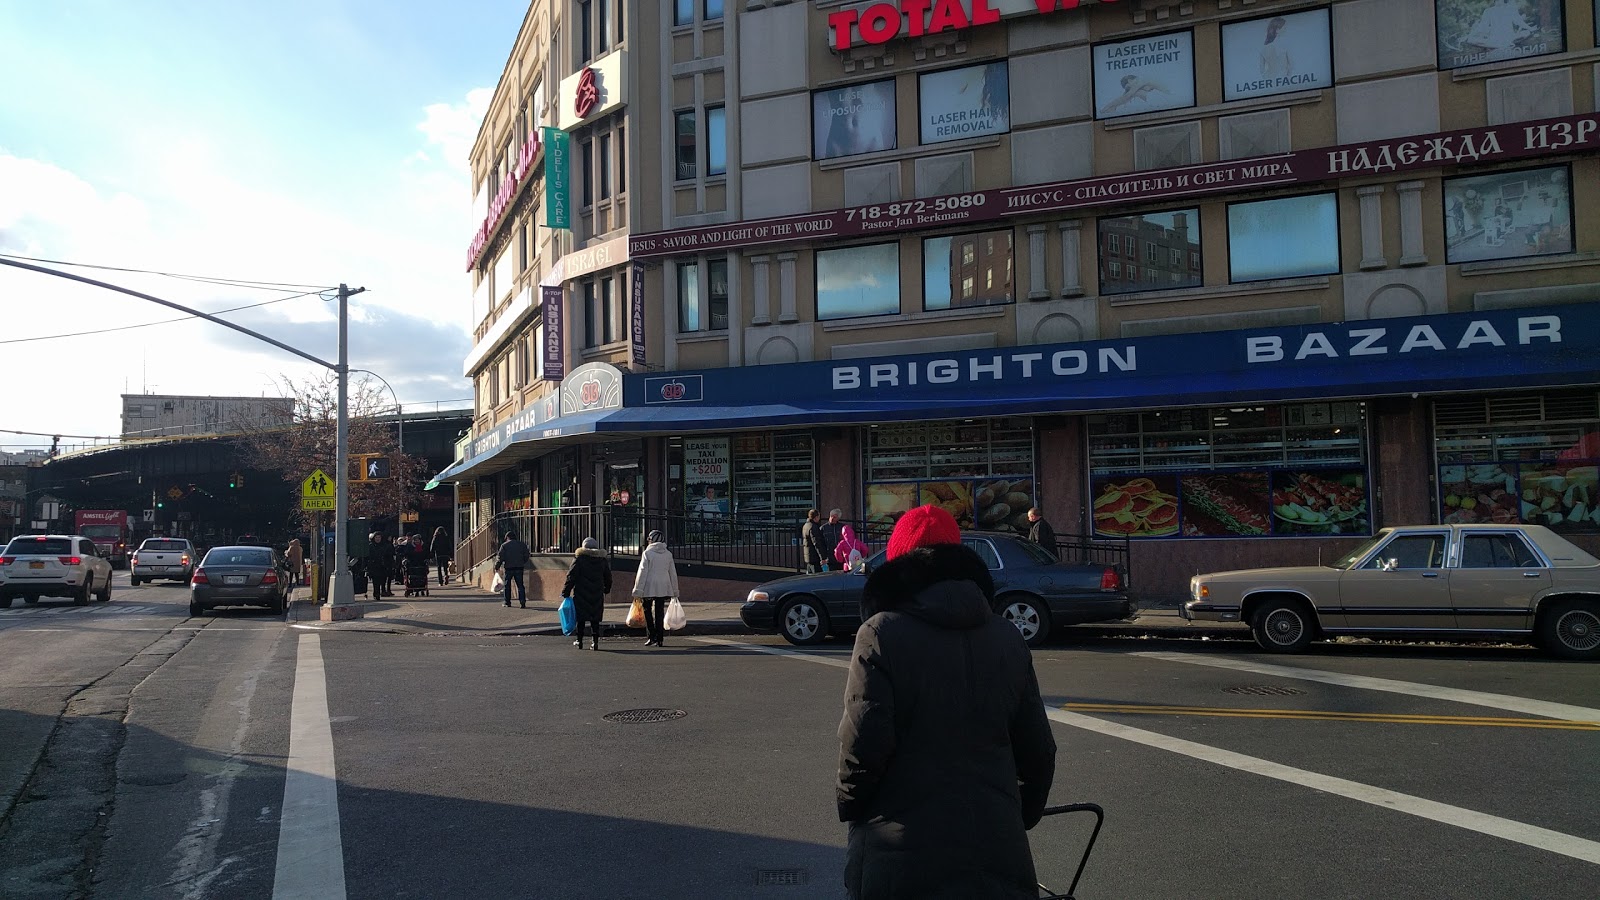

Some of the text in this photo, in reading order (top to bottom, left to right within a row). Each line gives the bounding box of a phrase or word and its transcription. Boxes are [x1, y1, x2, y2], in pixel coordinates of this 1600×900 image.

[829, 0, 1000, 50] TOTAL
[1107, 38, 1178, 59] LASER VEIN
[1106, 51, 1180, 71] TREATMENT
[1236, 72, 1318, 93] LASER FACIAL
[838, 90, 866, 102] LASE
[822, 100, 887, 118] LIPOSUCION
[931, 111, 967, 125] LASER
[937, 119, 993, 137] REMOVAL
[1327, 118, 1600, 174] НАДЕЖДА ИЗР
[553, 132, 565, 225] FIDELIS CARE
[1007, 190, 1064, 209] ИИСУС
[1074, 176, 1173, 199] СПАСИТЕЛЬ
[1177, 174, 1190, 188] И
[1192, 168, 1237, 186] СВЕТ
[1241, 161, 1293, 180] МИРА
[845, 193, 986, 222] 718-872-5080
[861, 210, 970, 231] Pastor Jan Berkmans
[629, 238, 657, 255] JESUS
[663, 233, 698, 249] SAVIOR
[700, 230, 721, 245] AND
[722, 227, 753, 243] LIGHT
[755, 226, 769, 239] OF
[770, 223, 792, 238] THE
[794, 219, 834, 234] WORLD
[566, 245, 613, 276] ISRAEL
[634, 273, 642, 343] INSURANCE
[548, 297, 559, 361] INSURANCE
[832, 315, 1562, 390] BRIGHTON BAZAAR
[474, 409, 536, 456] BRIGHTON BAZAAR
[686, 457, 728, 465] MEDALLION
[698, 450, 715, 458] TAXI
[692, 464, 722, 475] +$200
[305, 500, 332, 508] AHEAD
